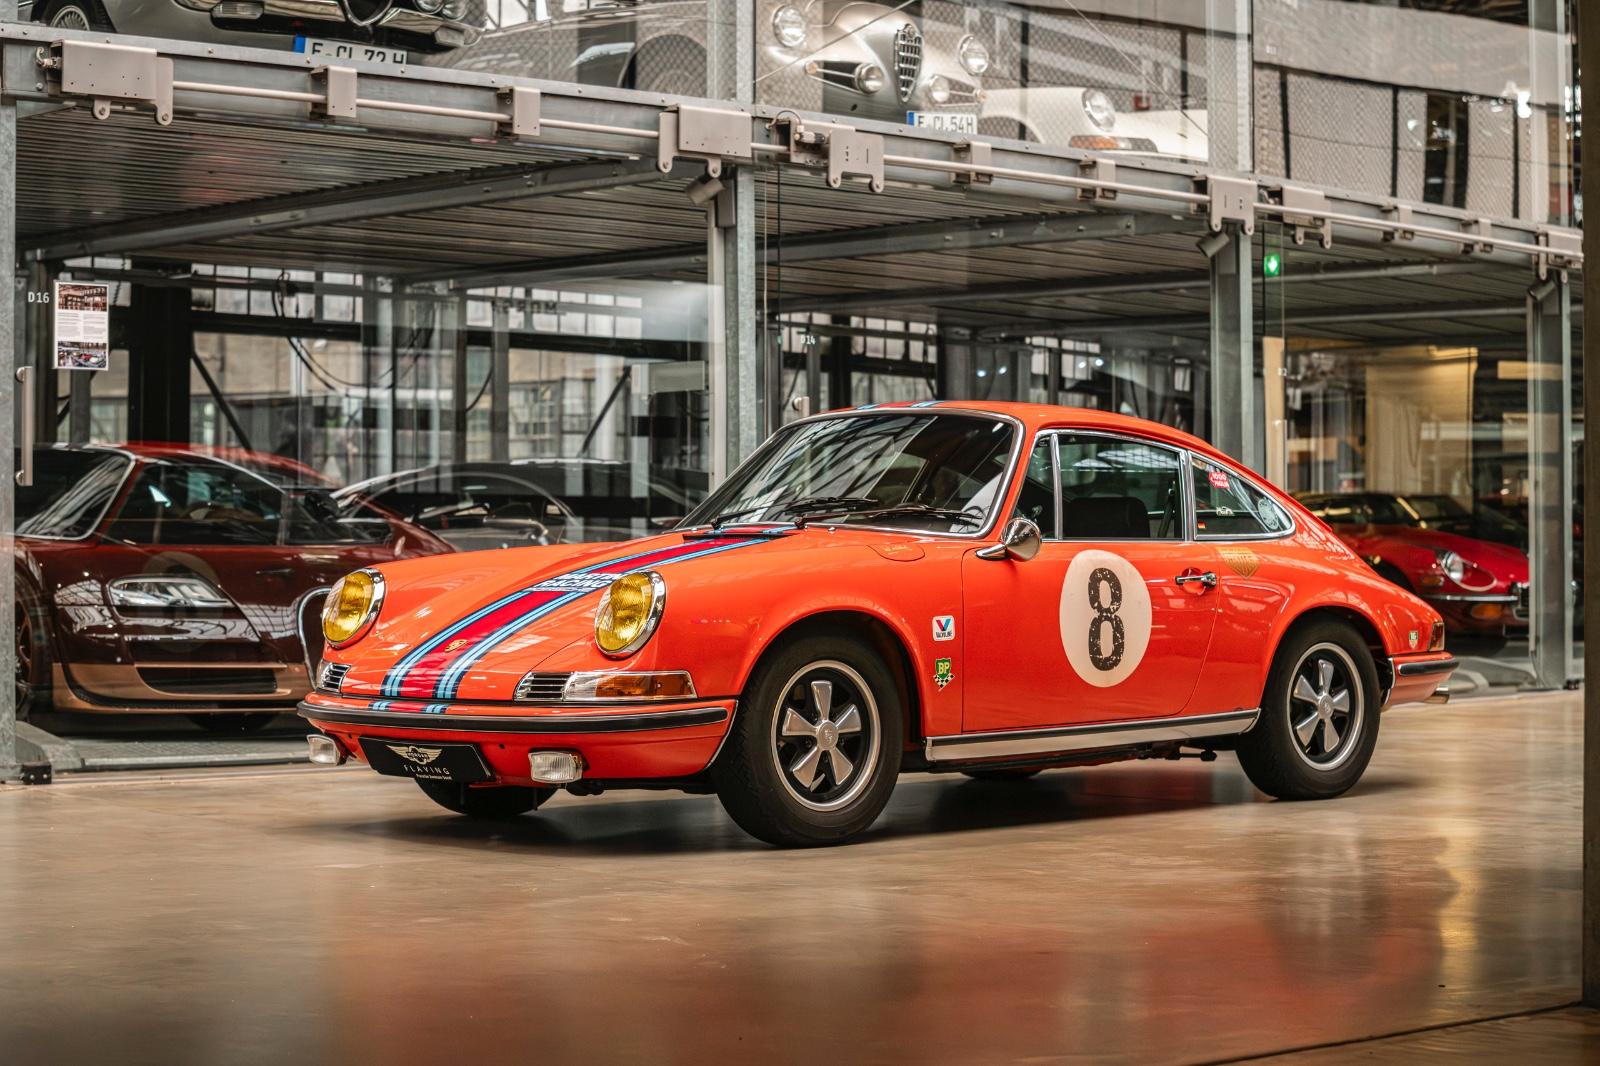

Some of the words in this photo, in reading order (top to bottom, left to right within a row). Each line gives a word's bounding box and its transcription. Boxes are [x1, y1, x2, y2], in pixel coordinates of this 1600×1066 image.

[28, 291, 50, 304] D16
[1088, 567, 1125, 671] 8
[938, 662, 950, 675] BP
[403, 764, 450, 775] FLAVING
